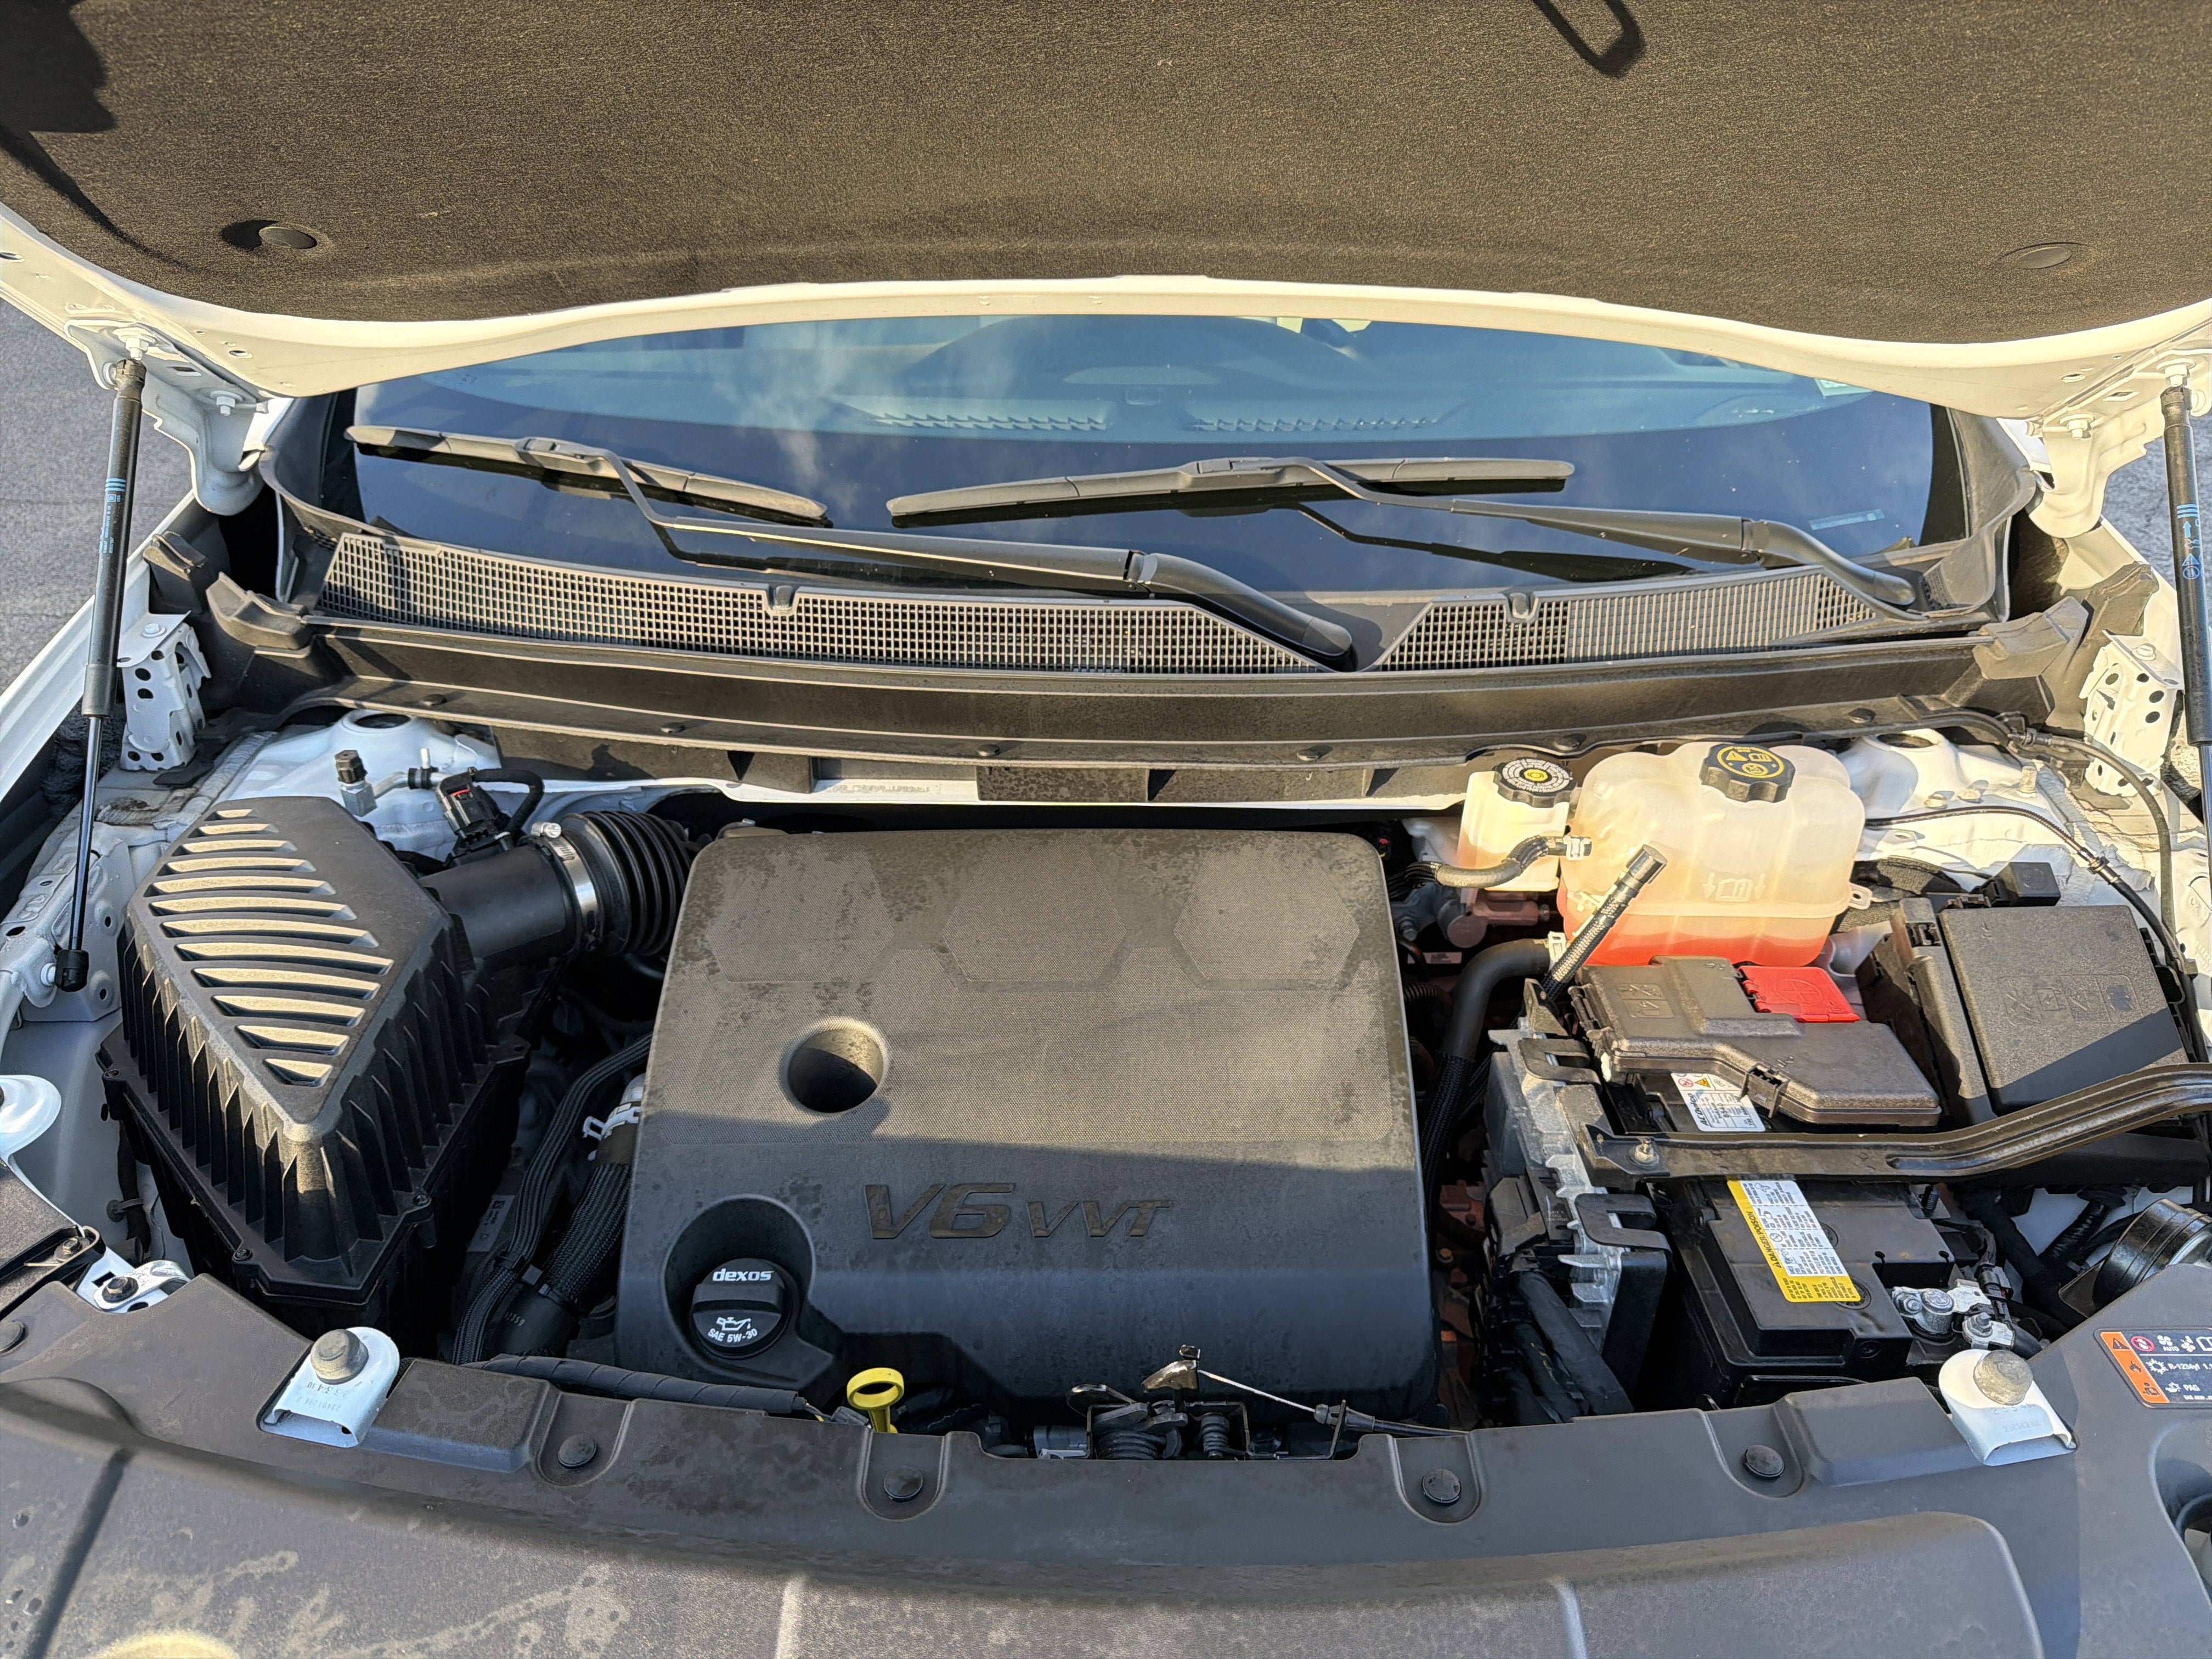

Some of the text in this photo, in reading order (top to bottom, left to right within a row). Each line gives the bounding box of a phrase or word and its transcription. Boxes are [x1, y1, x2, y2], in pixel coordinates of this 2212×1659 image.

[1688, 1093, 1709, 1126] ACDelco
[864, 1183, 1173, 1240] V6 VVT
[1746, 1211, 1778, 1261] DANGER/POISON
[712, 1268, 775, 1282] dexos
[708, 1328, 758, 1343] SAE 5W-30
